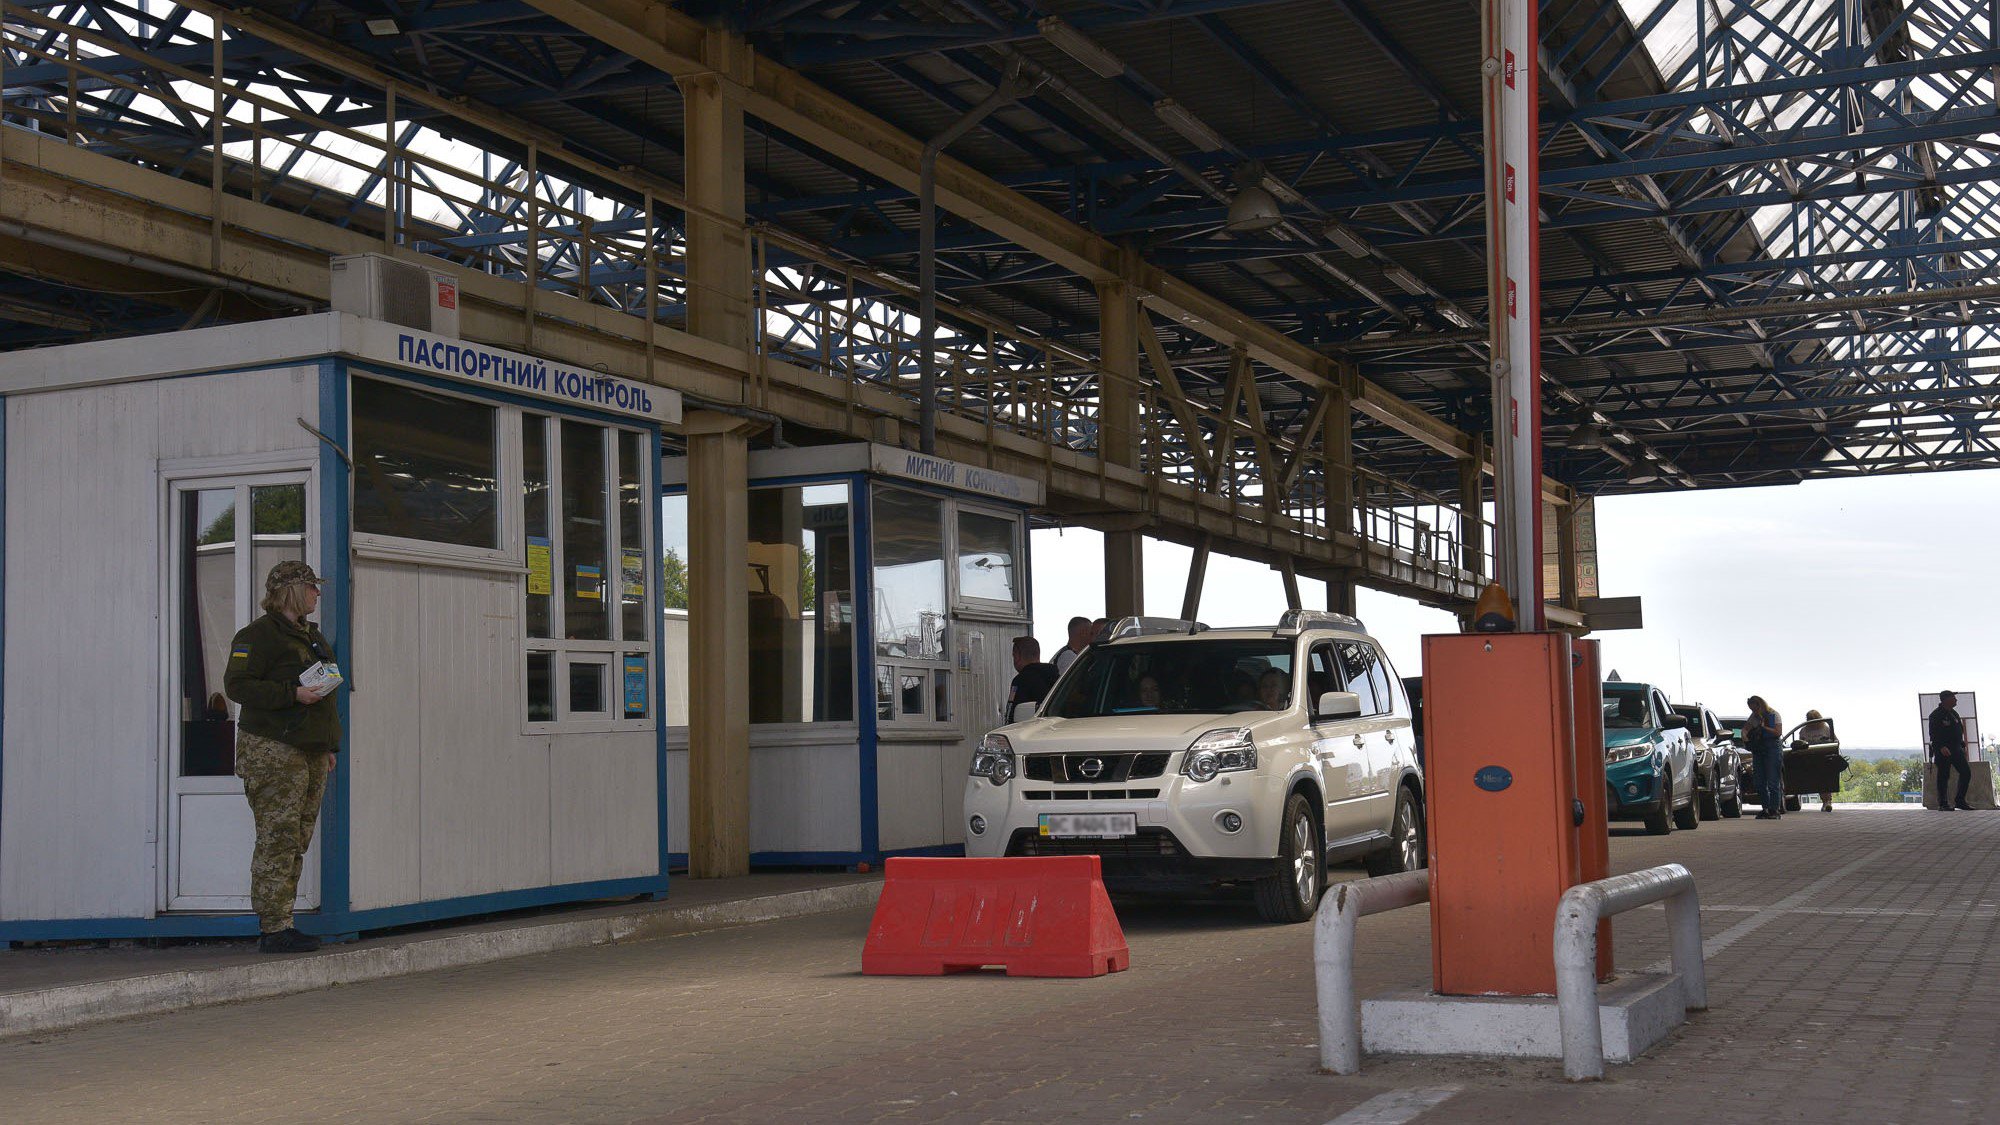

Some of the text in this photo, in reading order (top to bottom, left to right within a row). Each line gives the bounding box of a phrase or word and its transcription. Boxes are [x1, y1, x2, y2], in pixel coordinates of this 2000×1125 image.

[1506, 62, 1514, 78] Nice
[1506, 176, 1514, 192] Nice
[399, 334, 652, 413] ПАСПОРТНИЙ КОНТРОЛЬ
[905, 454, 955, 483] МИТНИЙ
